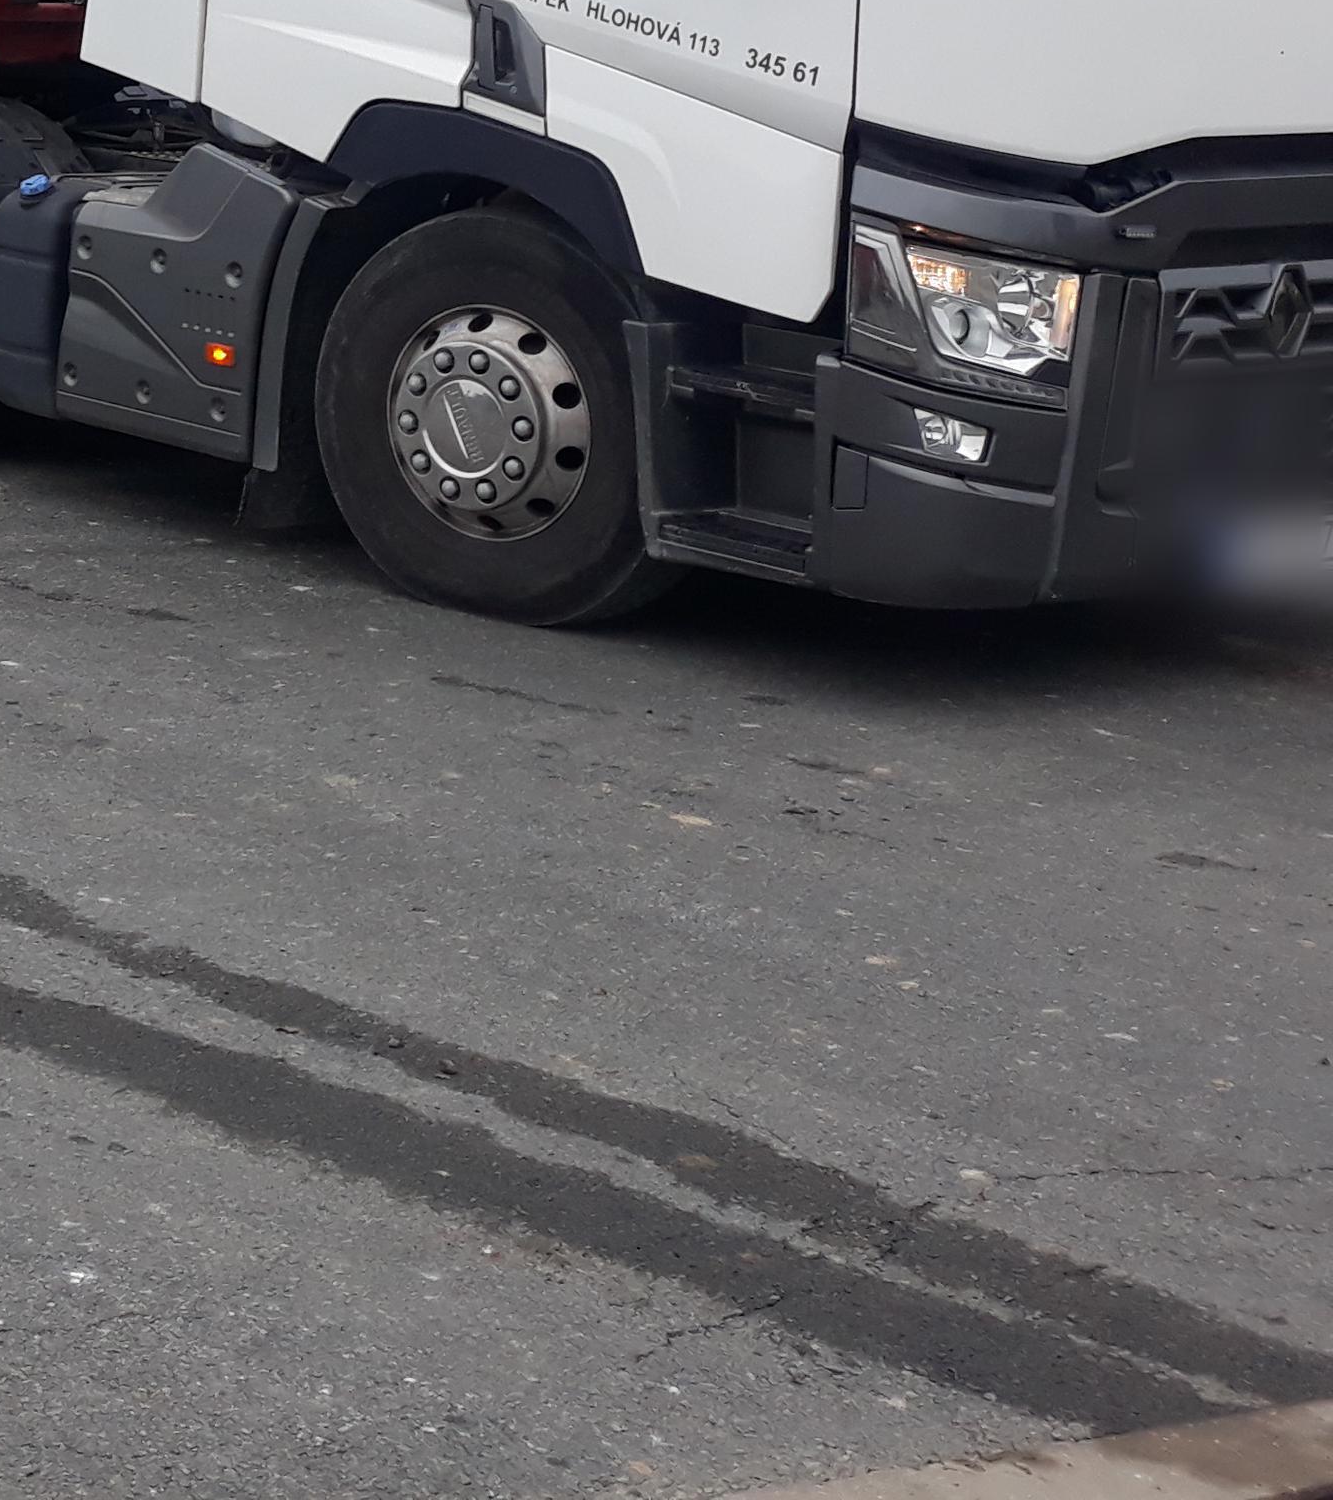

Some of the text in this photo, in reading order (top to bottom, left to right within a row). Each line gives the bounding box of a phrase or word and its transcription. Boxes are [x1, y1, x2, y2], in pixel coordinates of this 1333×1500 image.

[586, 0, 681, 46] HLOHOVÁ
[689, 32, 721, 58] 113
[745, 48, 785, 77] 345
[792, 61, 820, 86] 61
